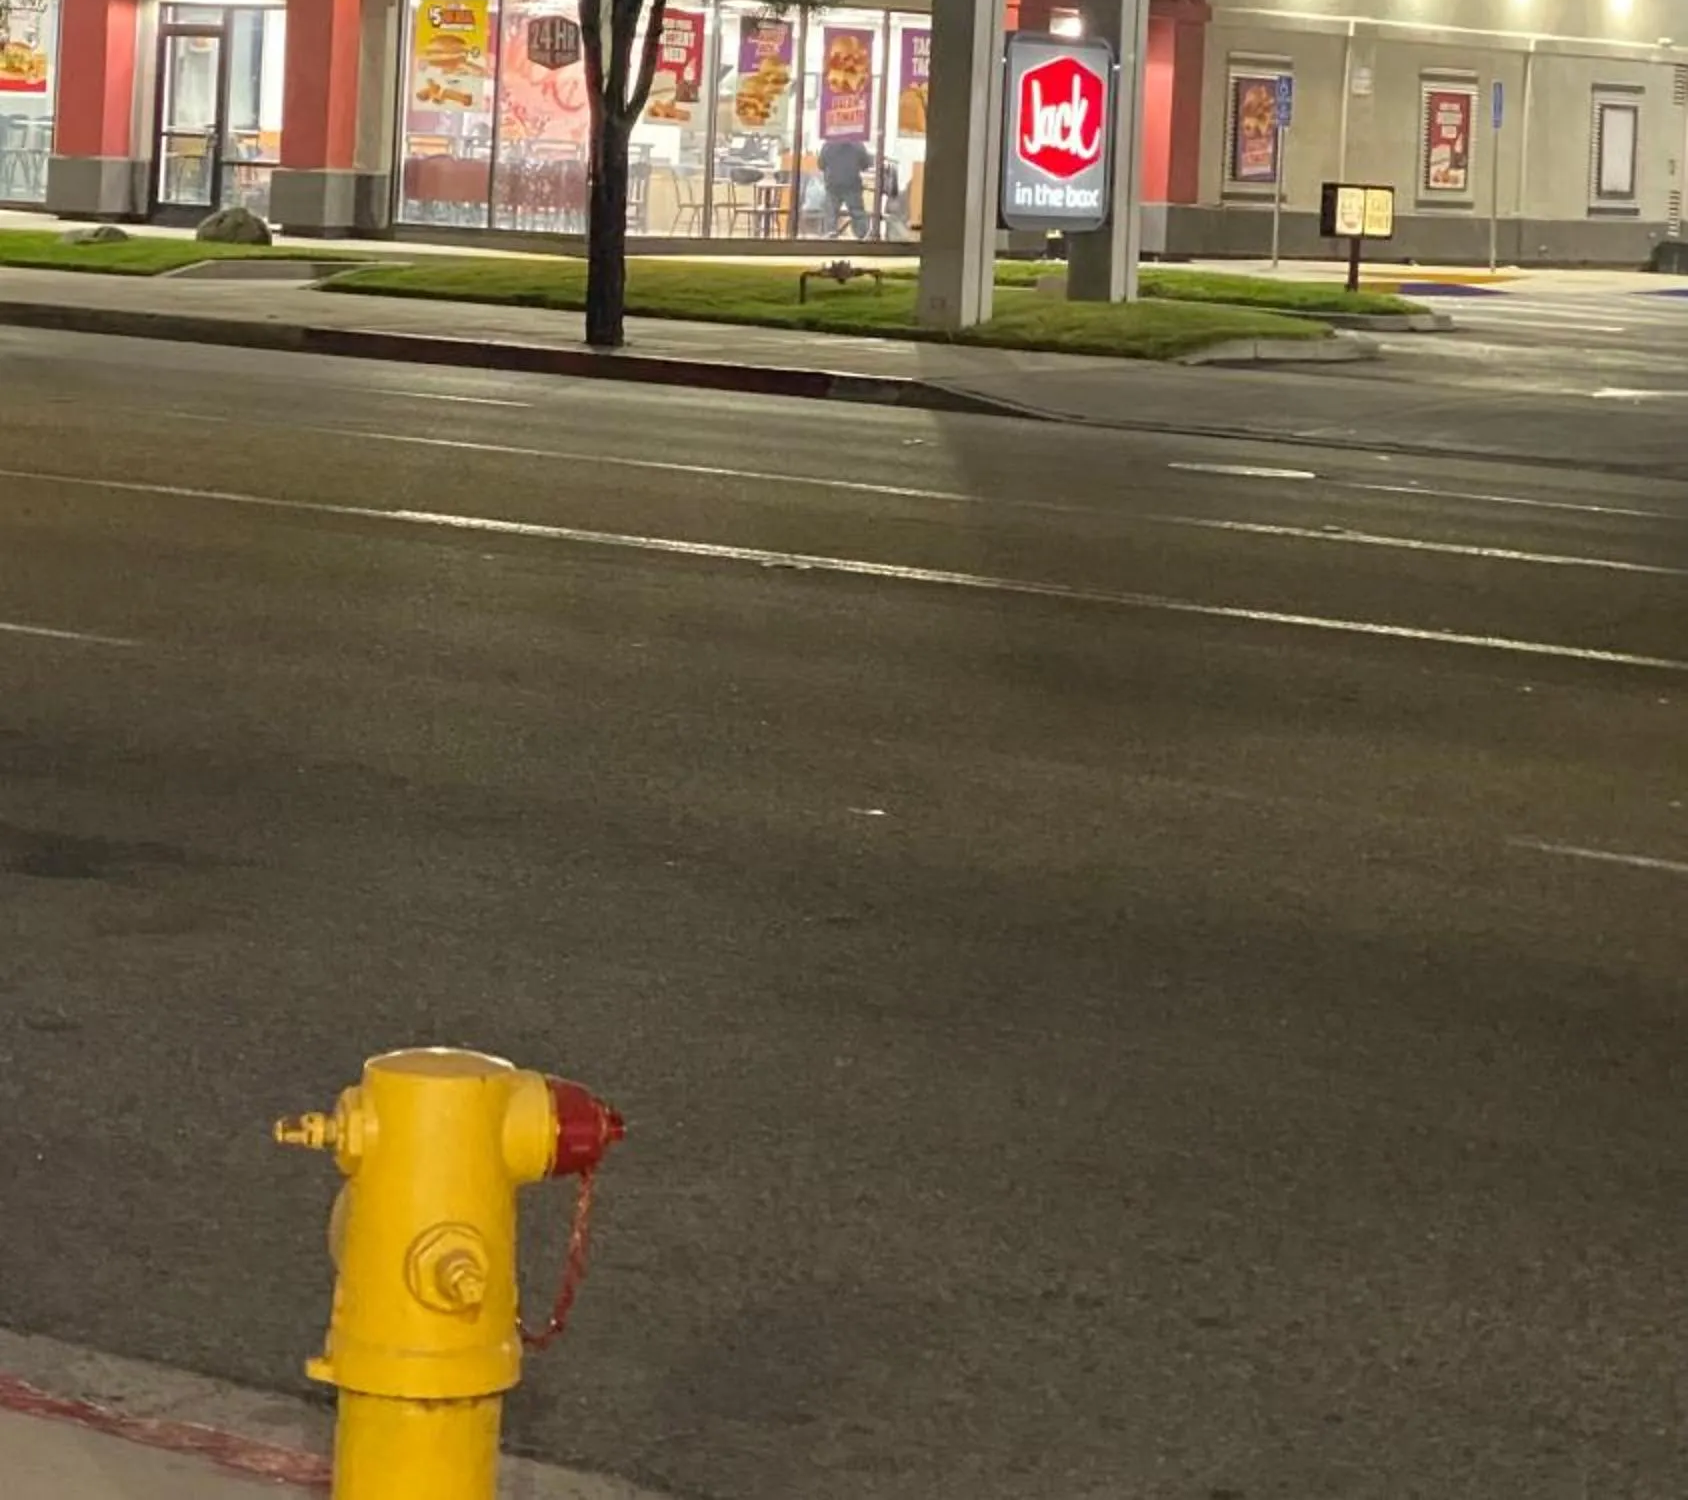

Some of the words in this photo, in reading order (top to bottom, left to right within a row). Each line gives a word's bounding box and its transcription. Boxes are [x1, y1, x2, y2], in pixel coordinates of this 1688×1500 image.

[1023, 73, 1101, 159] Jack
[1015, 181, 1033, 206] in
[1034, 183, 1064, 207] the
[1065, 185, 1099, 208] box
